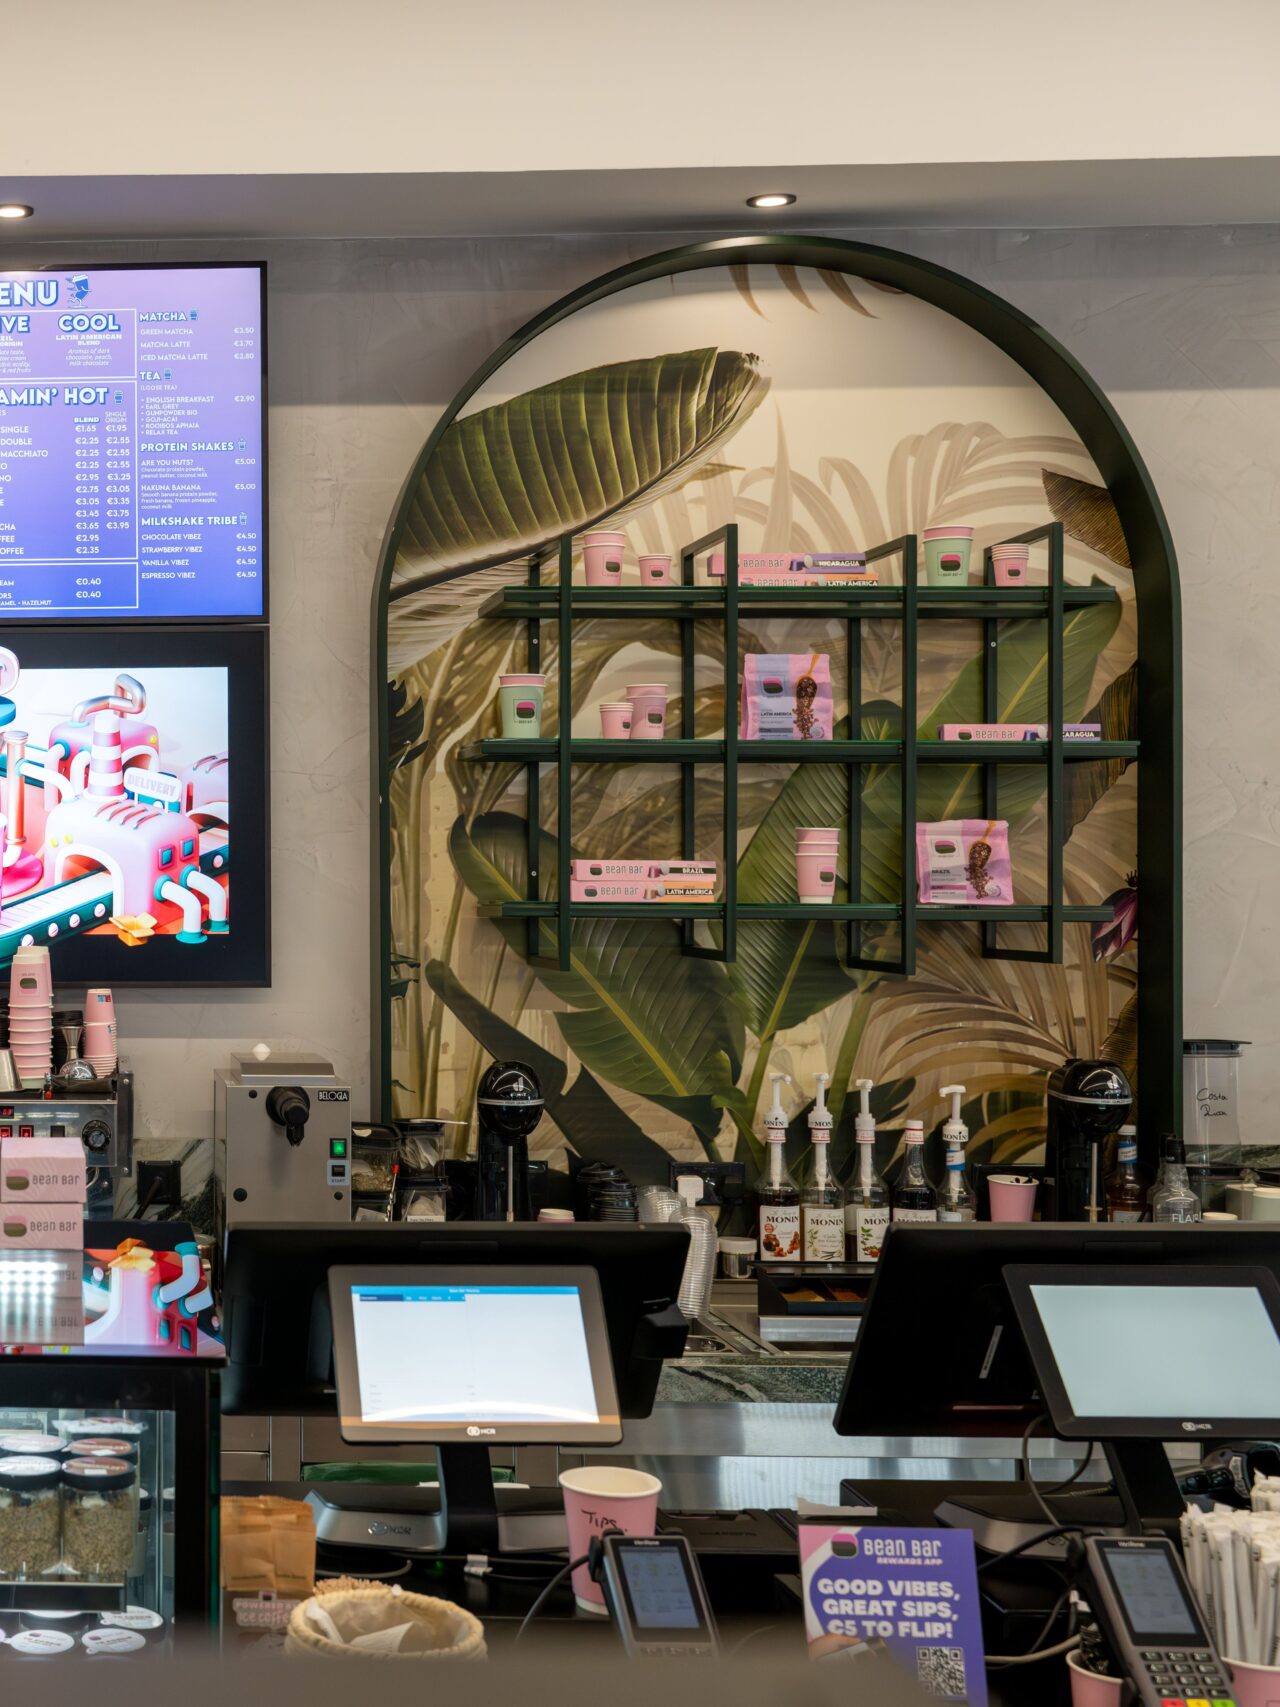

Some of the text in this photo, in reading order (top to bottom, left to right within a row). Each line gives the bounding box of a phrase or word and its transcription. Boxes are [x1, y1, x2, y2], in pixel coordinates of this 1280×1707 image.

[58, 314, 120, 332] COOL
[139, 312, 187, 322] MATCHA
[140, 371, 160, 382] TEA
[63, 386, 108, 404] HOT
[141, 442, 233, 451] PROTEIN SHAKES
[142, 516, 238, 525] MILKSHAKE TRIBE
[127, 774, 176, 796] DELIVERY
[318, 1091, 348, 1101] BELOGIA
[1197, 1088, 1228, 1101] Costa
[810, 1218, 844, 1226] MONIN
[876, 1557, 922, 1565] REWARDS
[817, 1578, 960, 1601] GOOD VIBES,
[822, 1598, 958, 1622] GREAT SIPS,
[826, 1619, 953, 1639] €5 TO FLIP!
